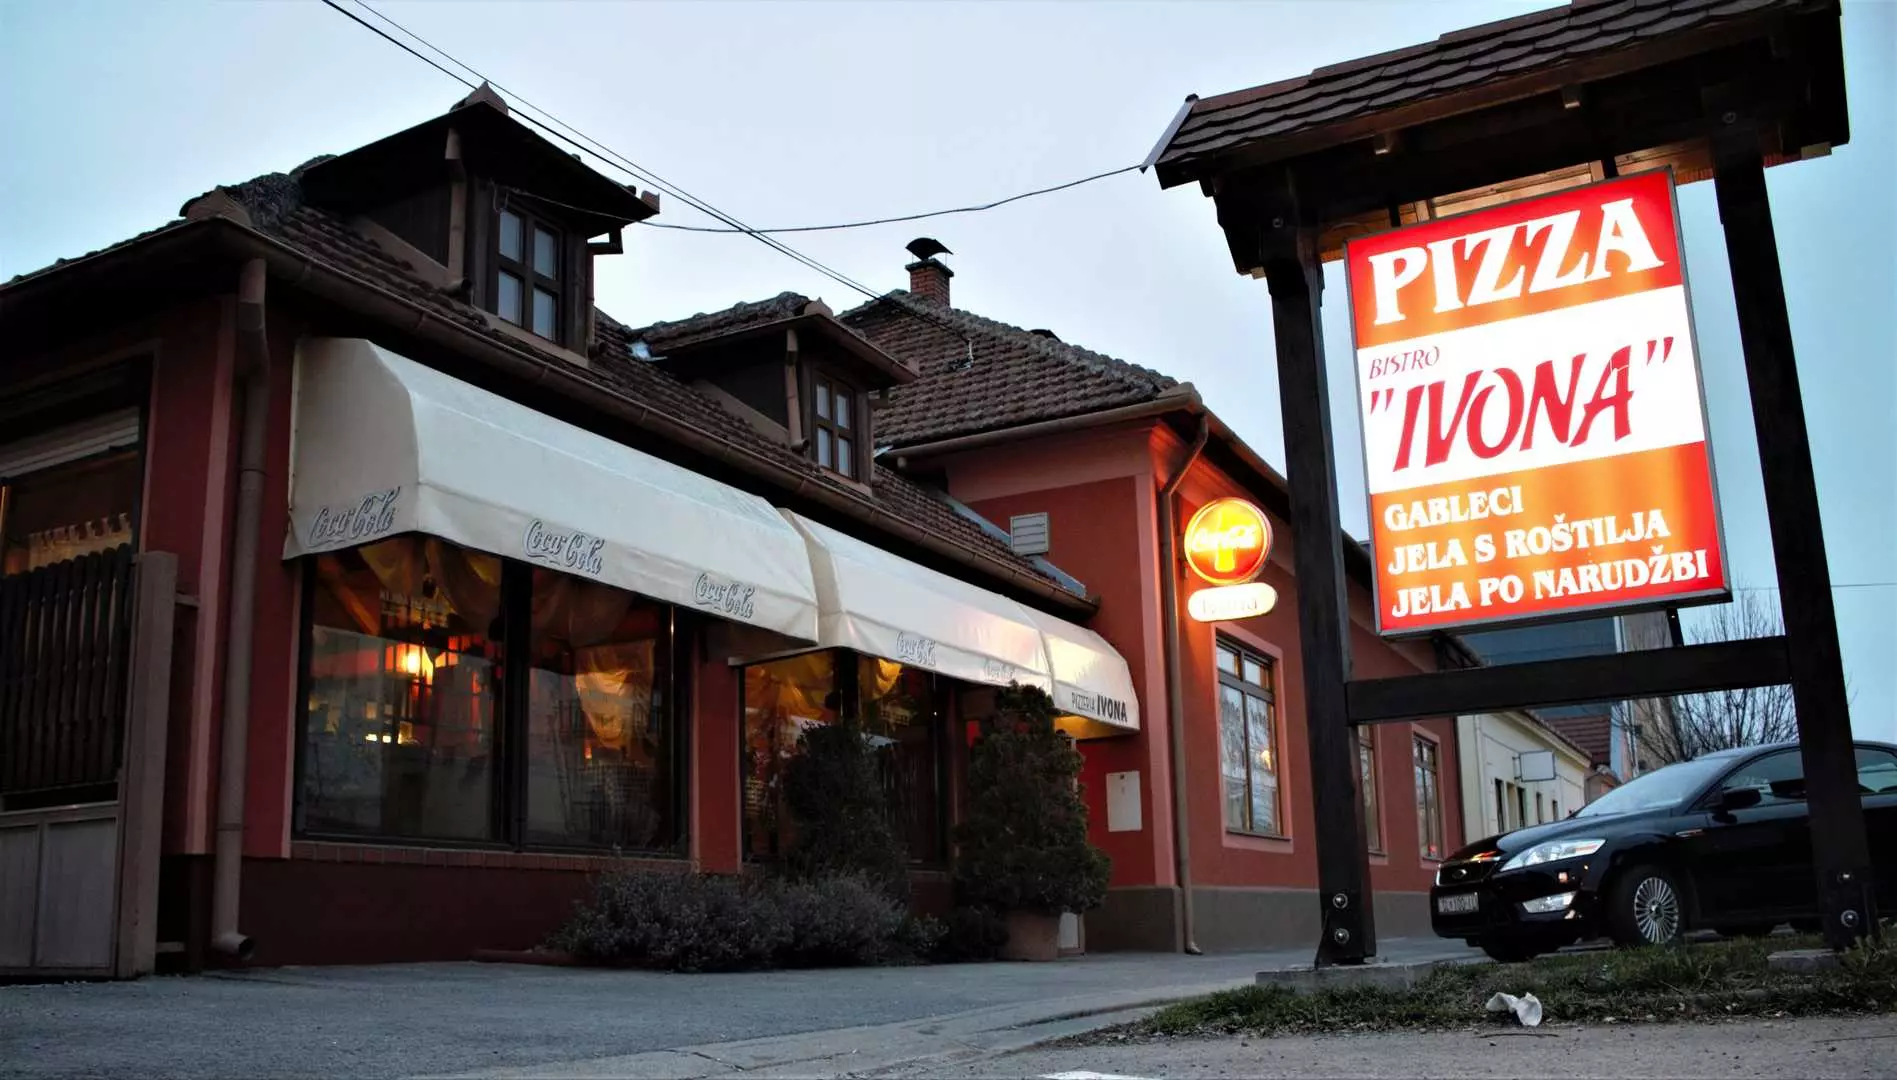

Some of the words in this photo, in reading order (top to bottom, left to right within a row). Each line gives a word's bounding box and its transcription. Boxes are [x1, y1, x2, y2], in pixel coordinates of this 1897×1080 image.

[1368, 198, 1664, 326] PIZZA
[1369, 345, 1440, 380] BISTRO
[1384, 485, 1524, 532] GABLECI
[1388, 539, 1468, 575] JELA
[1474, 533, 1496, 564] S
[1505, 508, 1671, 559] ROŠTILJA
[1392, 580, 1473, 618] JELA
[1479, 575, 1525, 607] PO
[1533, 544, 1710, 600] NARUDŽBI
[1096, 693, 1129, 724] IVONA
